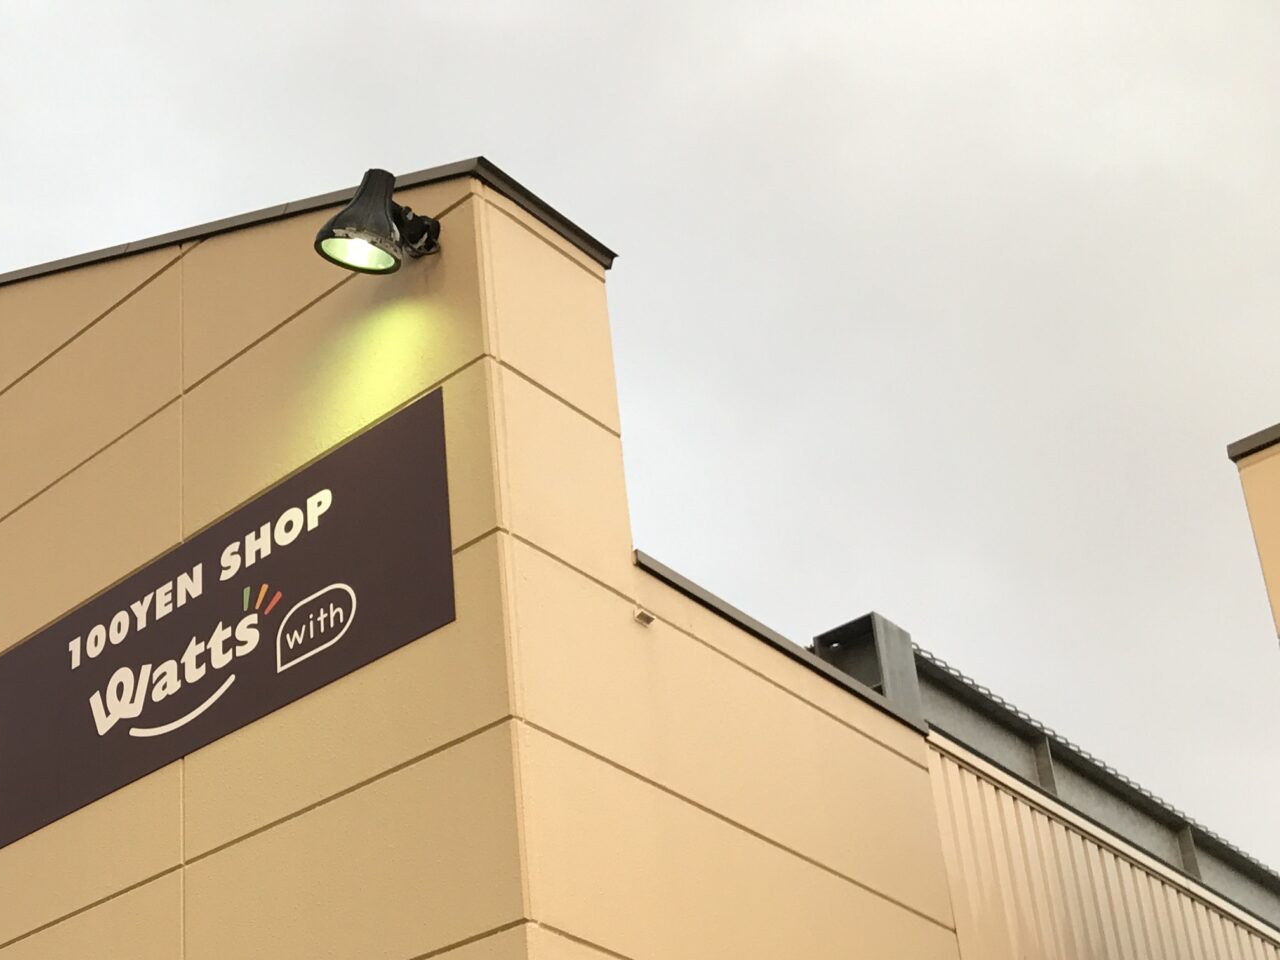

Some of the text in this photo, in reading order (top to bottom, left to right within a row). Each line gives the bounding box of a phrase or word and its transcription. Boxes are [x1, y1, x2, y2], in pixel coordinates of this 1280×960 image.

[69, 489, 332, 669] 100YEN SHOP
[286, 603, 344, 650] with
[90, 614, 259, 736] Watts
